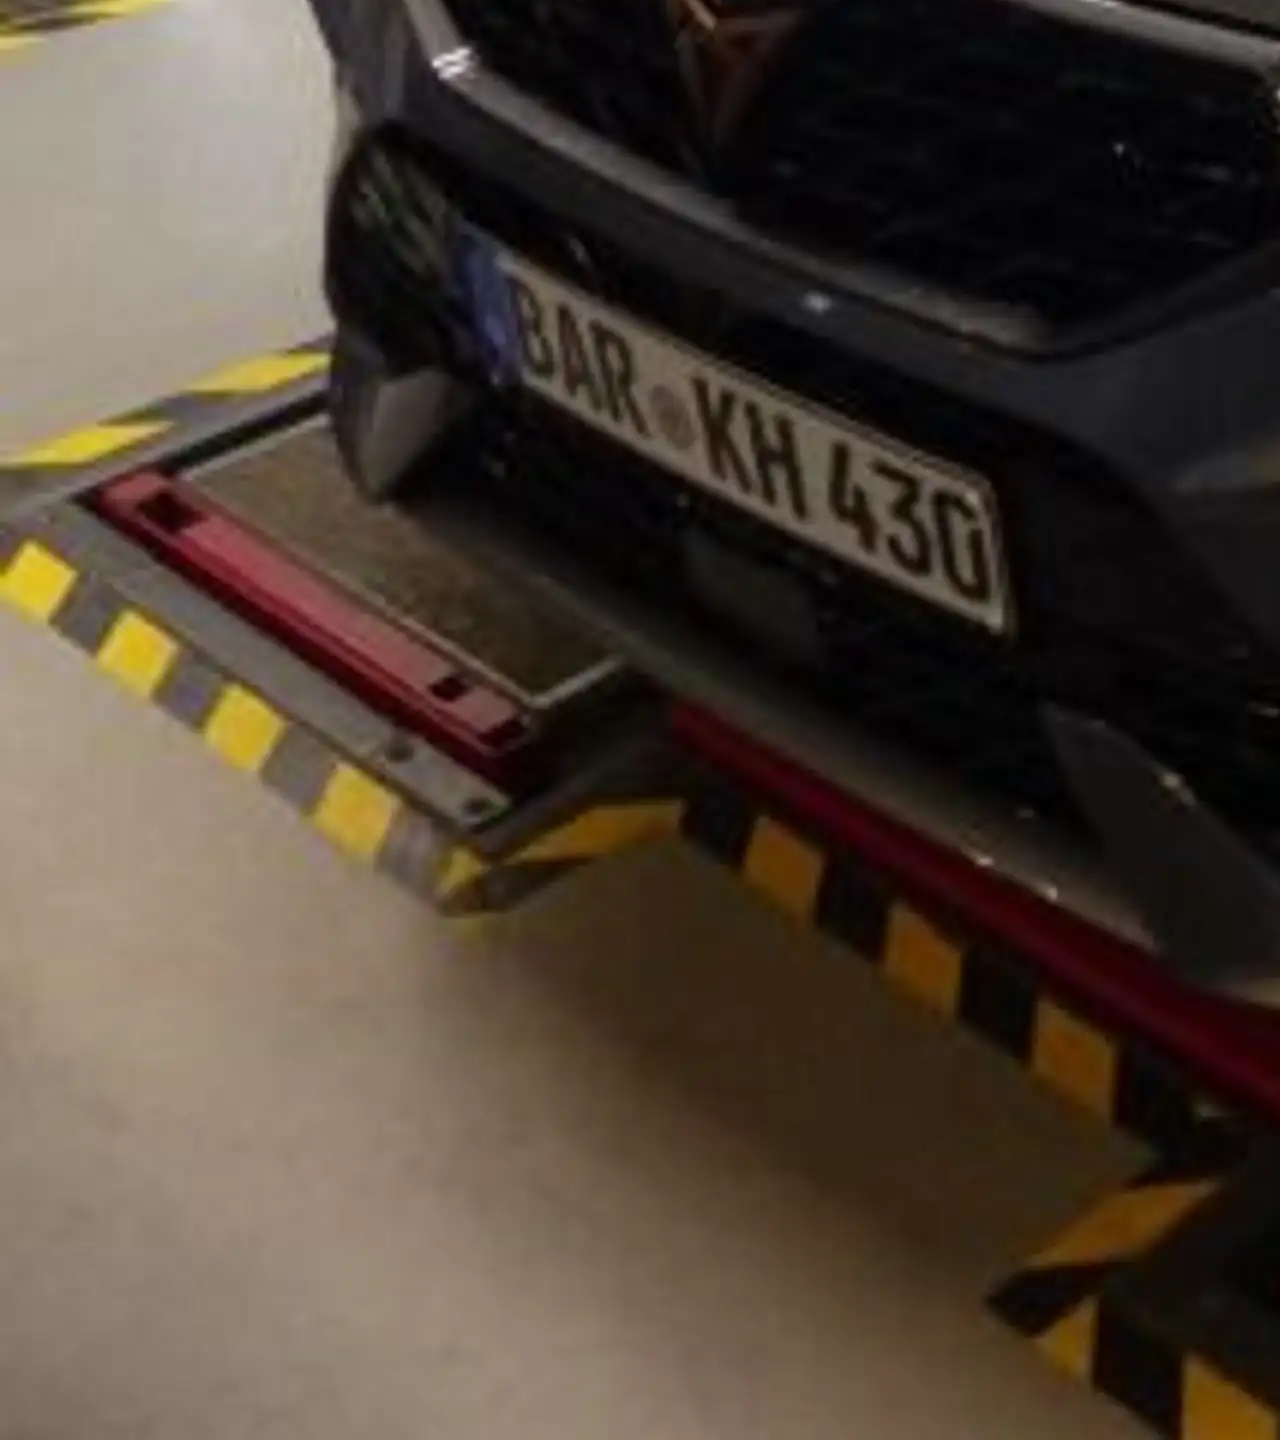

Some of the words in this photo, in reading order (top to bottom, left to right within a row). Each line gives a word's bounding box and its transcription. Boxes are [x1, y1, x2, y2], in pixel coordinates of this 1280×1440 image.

[515, 279, 650, 437] BAR
[692, 377, 808, 522] KH
[828, 444, 992, 602] 430
